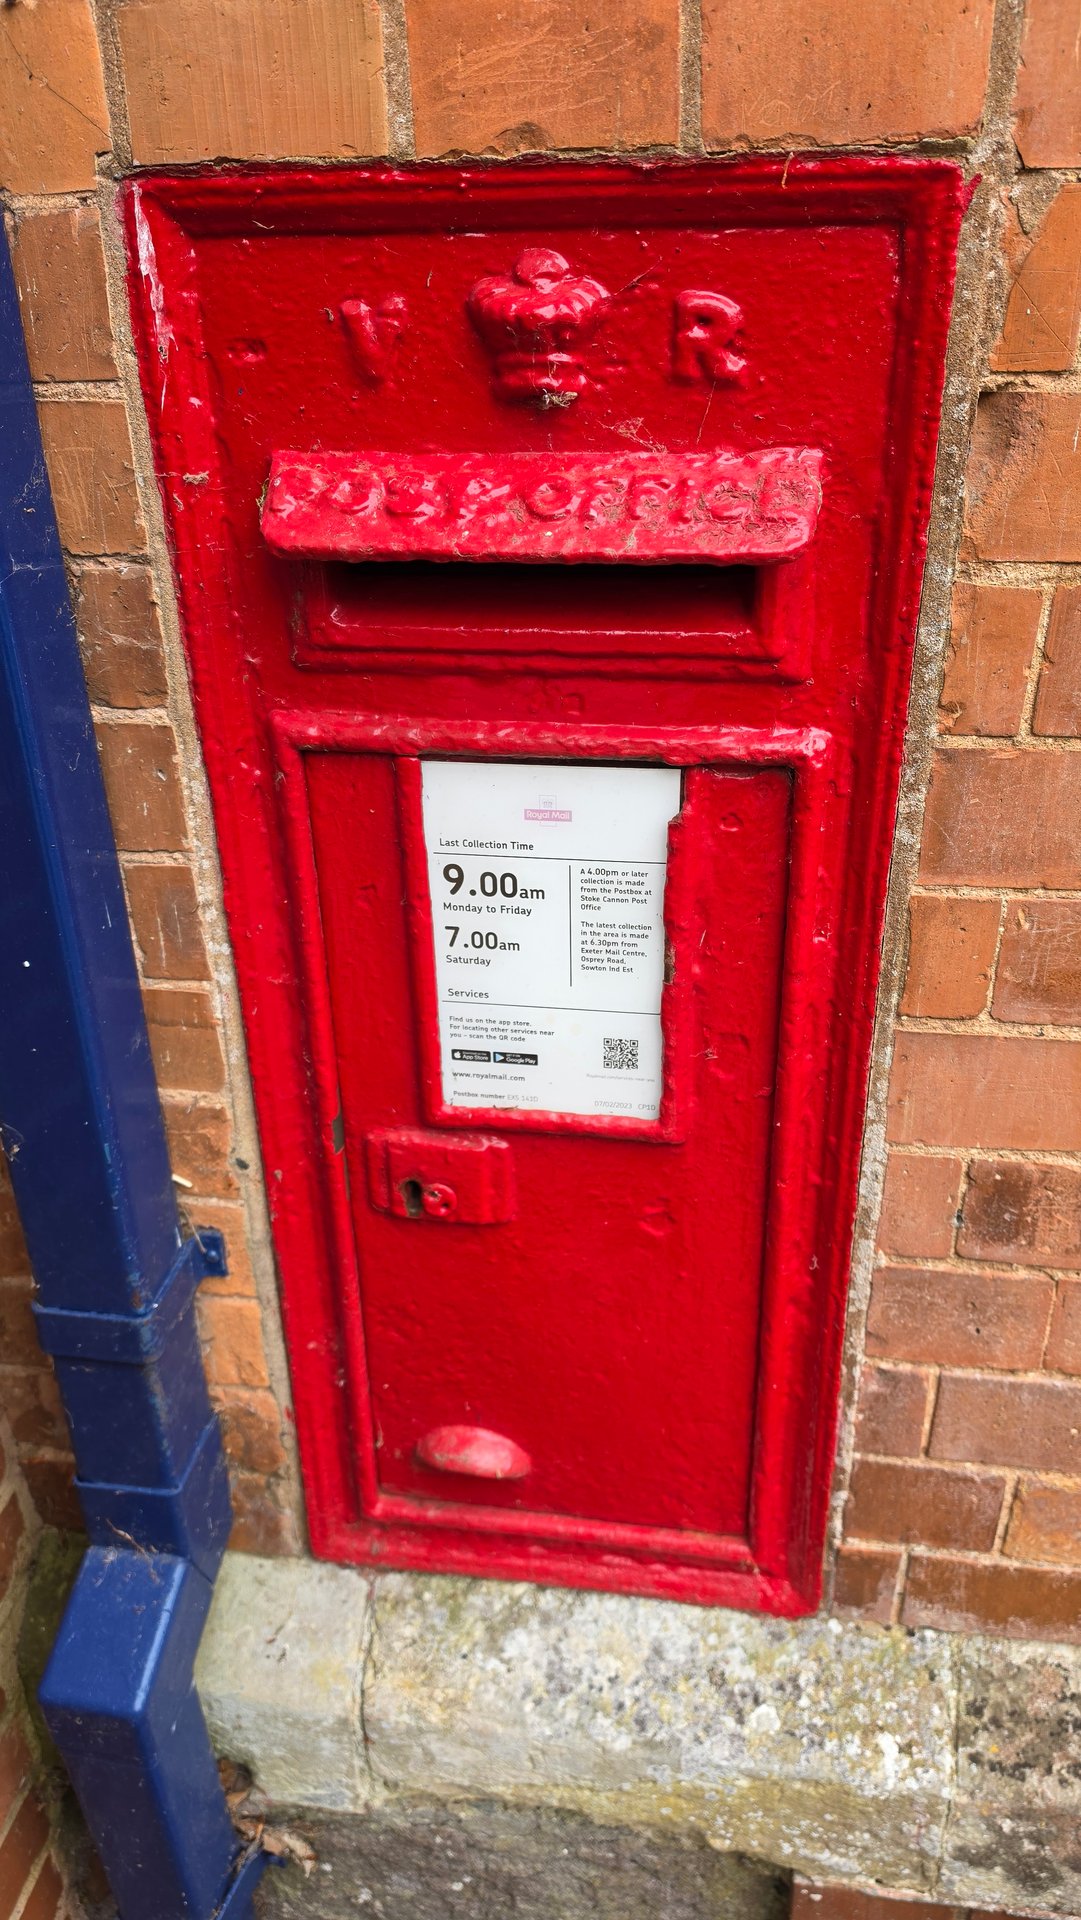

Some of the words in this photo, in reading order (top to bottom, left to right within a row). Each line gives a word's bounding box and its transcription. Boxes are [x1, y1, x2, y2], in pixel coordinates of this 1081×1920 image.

[675, 289, 749, 386] R
[527, 811, 550, 820] Royal
[551, 811, 570, 820] Mail
[440, 838, 459, 847] Last
[462, 839, 508, 849] Collection
[511, 841, 534, 850] Time
[587, 868, 619, 877] 4.00pm
[631, 870, 648, 878] later
[443, 863, 545, 899] 9.00am
[614, 888, 642, 896] Postbox
[602, 896, 629, 904] Cannon
[443, 902, 483, 914] Monday
[486, 905, 496, 913] to
[500, 905, 532, 916] Friday
[618, 923, 652, 931] collection
[445, 926, 520, 951] 7.00am
[590, 940, 619, 948] 6.30pm
[446, 955, 491, 967] Saturday
[581, 956, 604, 964] Osprey
[448, 988, 489, 998] Services
[462, 1024, 488, 1032] locating
[452, 1071, 526, 1081] www.royalmail.com
